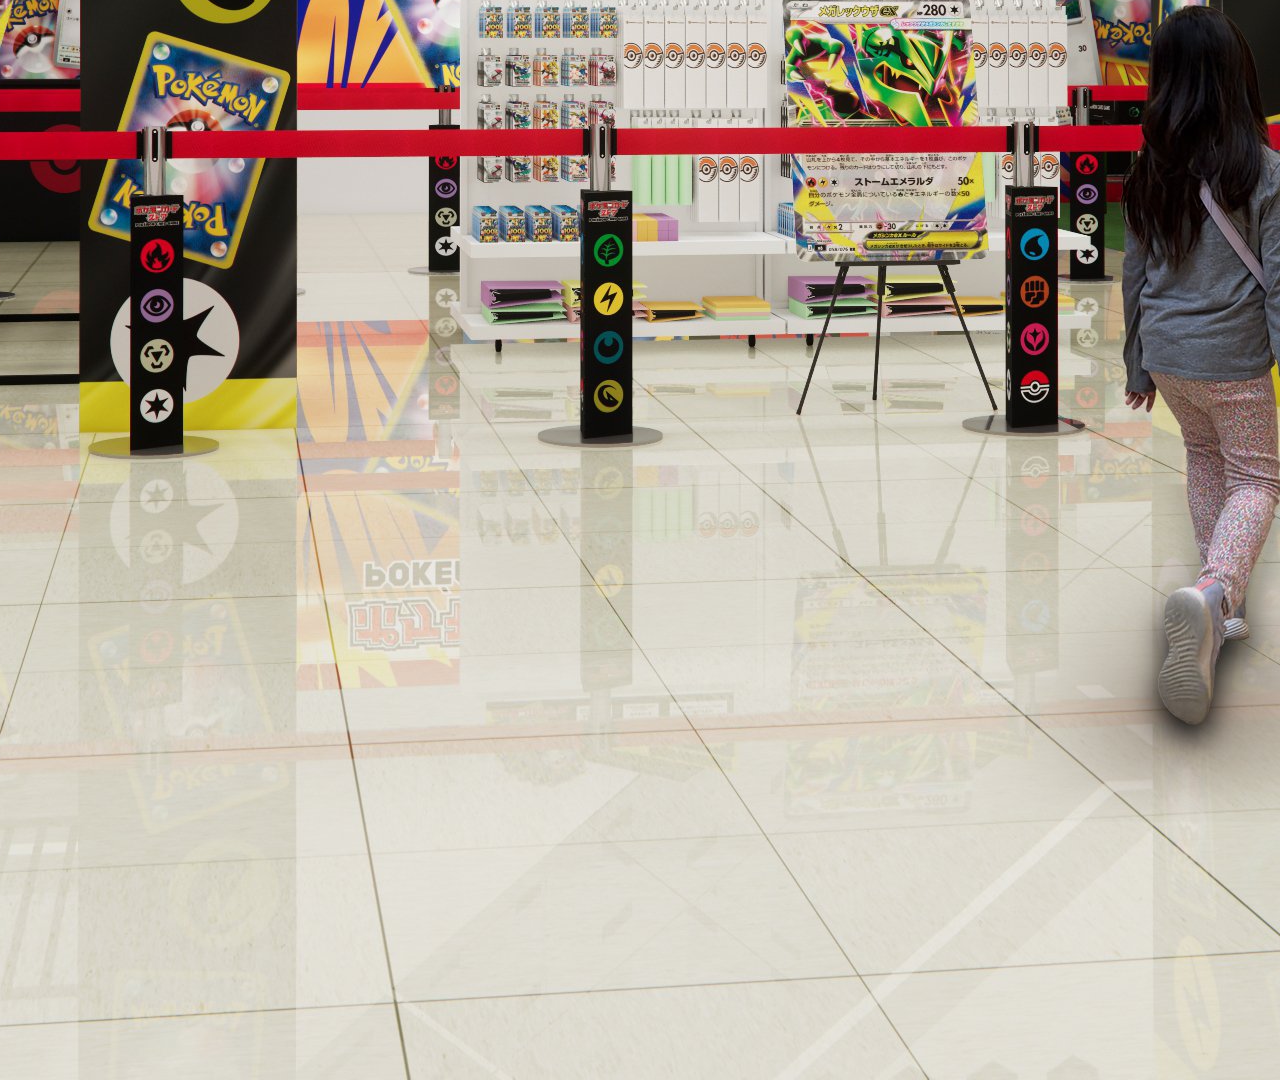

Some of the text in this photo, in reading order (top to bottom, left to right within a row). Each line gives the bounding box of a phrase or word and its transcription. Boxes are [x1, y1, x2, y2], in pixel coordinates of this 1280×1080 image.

[923, 4, 946, 16] 280
[854, 176, 934, 187] ストームエメラルダ
